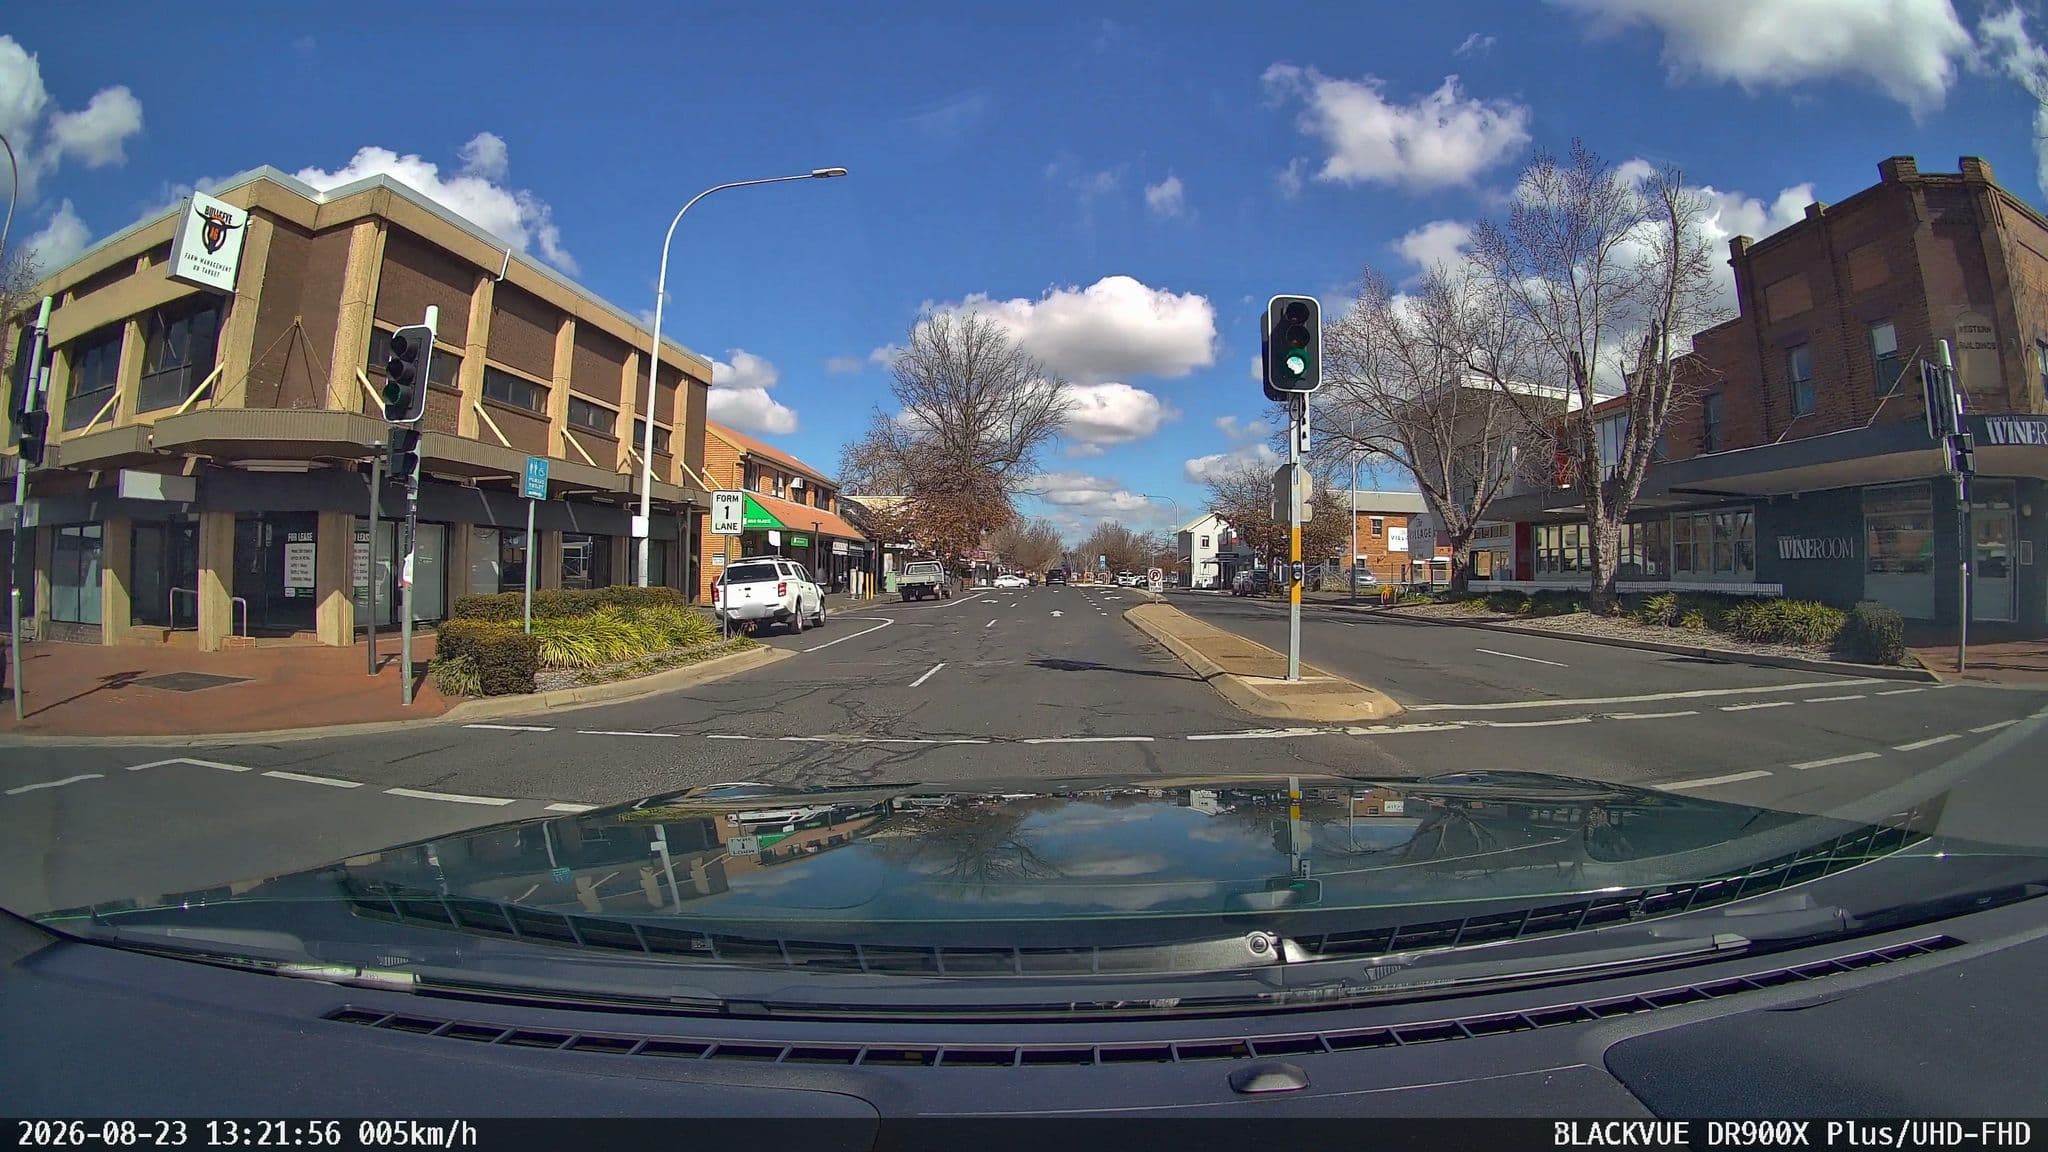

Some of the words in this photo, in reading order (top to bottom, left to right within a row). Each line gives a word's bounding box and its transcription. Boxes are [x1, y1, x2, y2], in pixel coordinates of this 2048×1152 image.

[184, 253, 198, 262] FARM
[200, 258, 231, 273] MANAGEMENT
[202, 267, 220, 278] TARGET
[716, 494, 739, 503] FORM
[724, 505, 730, 520] 1
[715, 522, 738, 531] LANE
[287, 532, 298, 542] FOR
[298, 532, 313, 542] LEASE
[1779, 536, 1855, 559] WINEROOM
